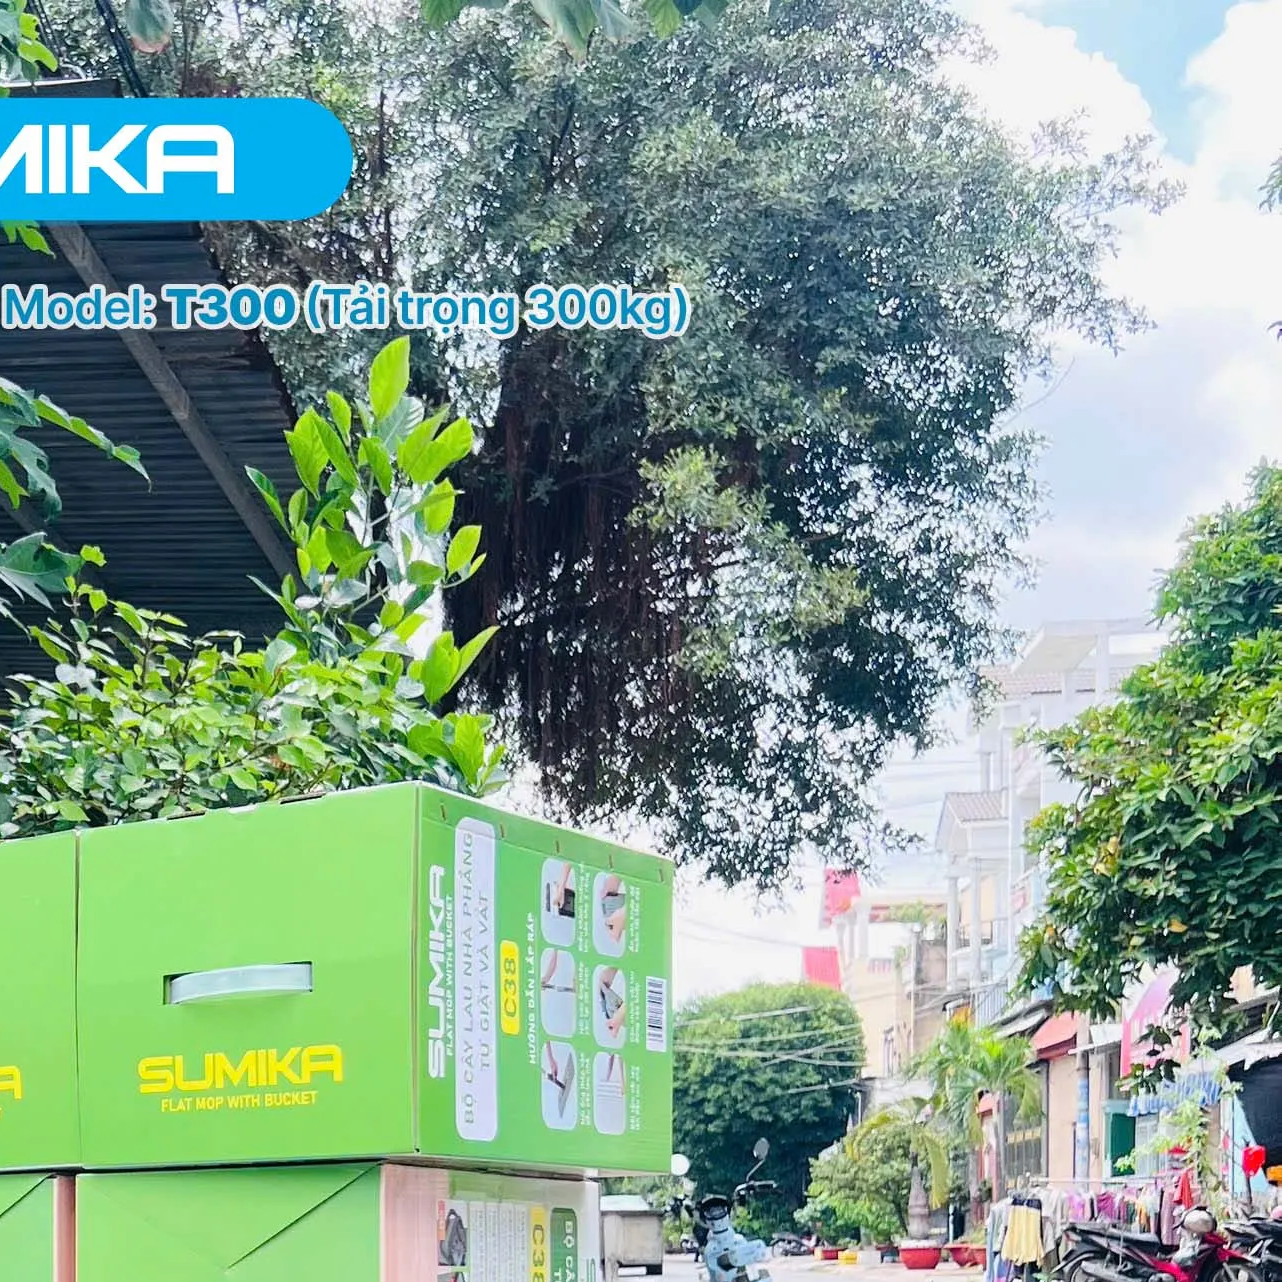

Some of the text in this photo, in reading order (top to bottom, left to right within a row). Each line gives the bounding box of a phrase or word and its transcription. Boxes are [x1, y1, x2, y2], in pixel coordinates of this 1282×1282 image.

[428, 865, 447, 1078] SUMIKA
[456, 831, 478, 1124] BỘ CÂY LAU NHÀ PHẲNG
[503, 957, 517, 1018] C38
[138, 1044, 343, 1094] SUMIKA
[161, 1091, 318, 1113] FLAT MOP WITH BUCKET
